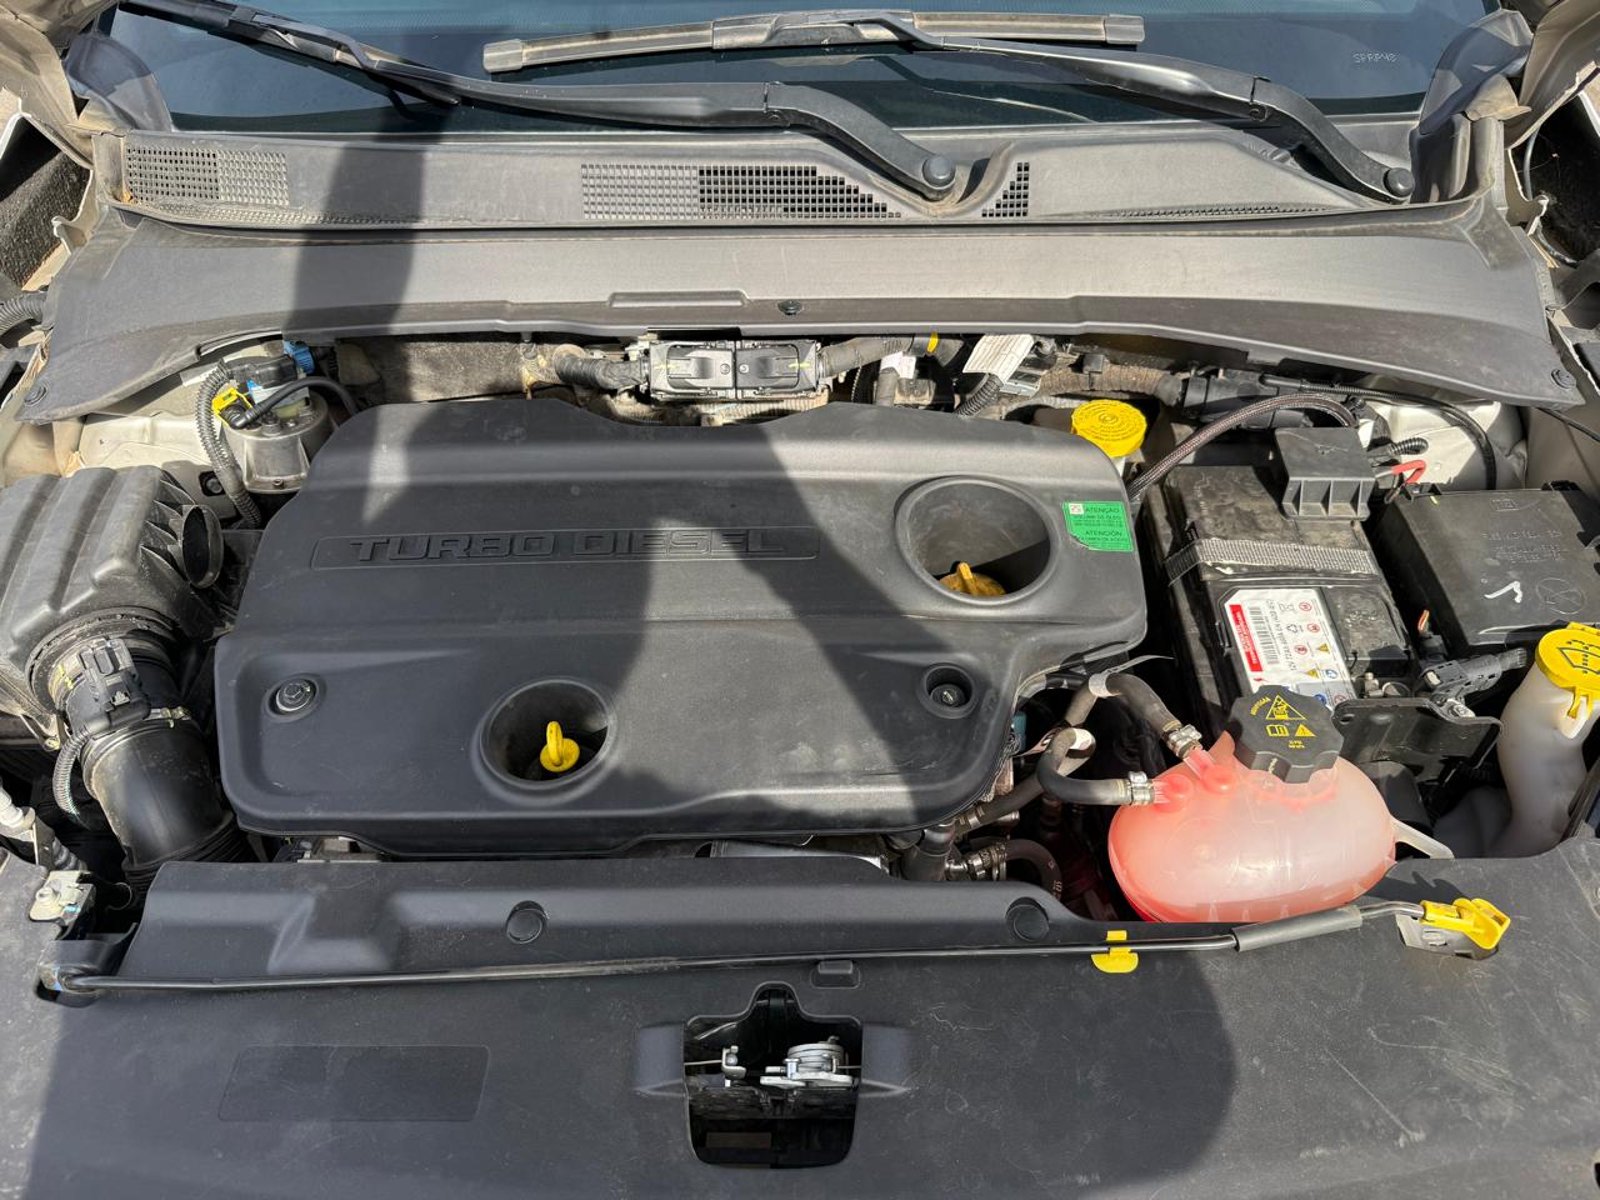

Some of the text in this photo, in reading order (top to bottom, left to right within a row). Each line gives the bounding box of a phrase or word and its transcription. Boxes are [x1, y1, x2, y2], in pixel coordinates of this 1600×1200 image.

[1085, 506, 1120, 514] ATENÇÃO
[349, 529, 784, 562] TURBO DIESEL
